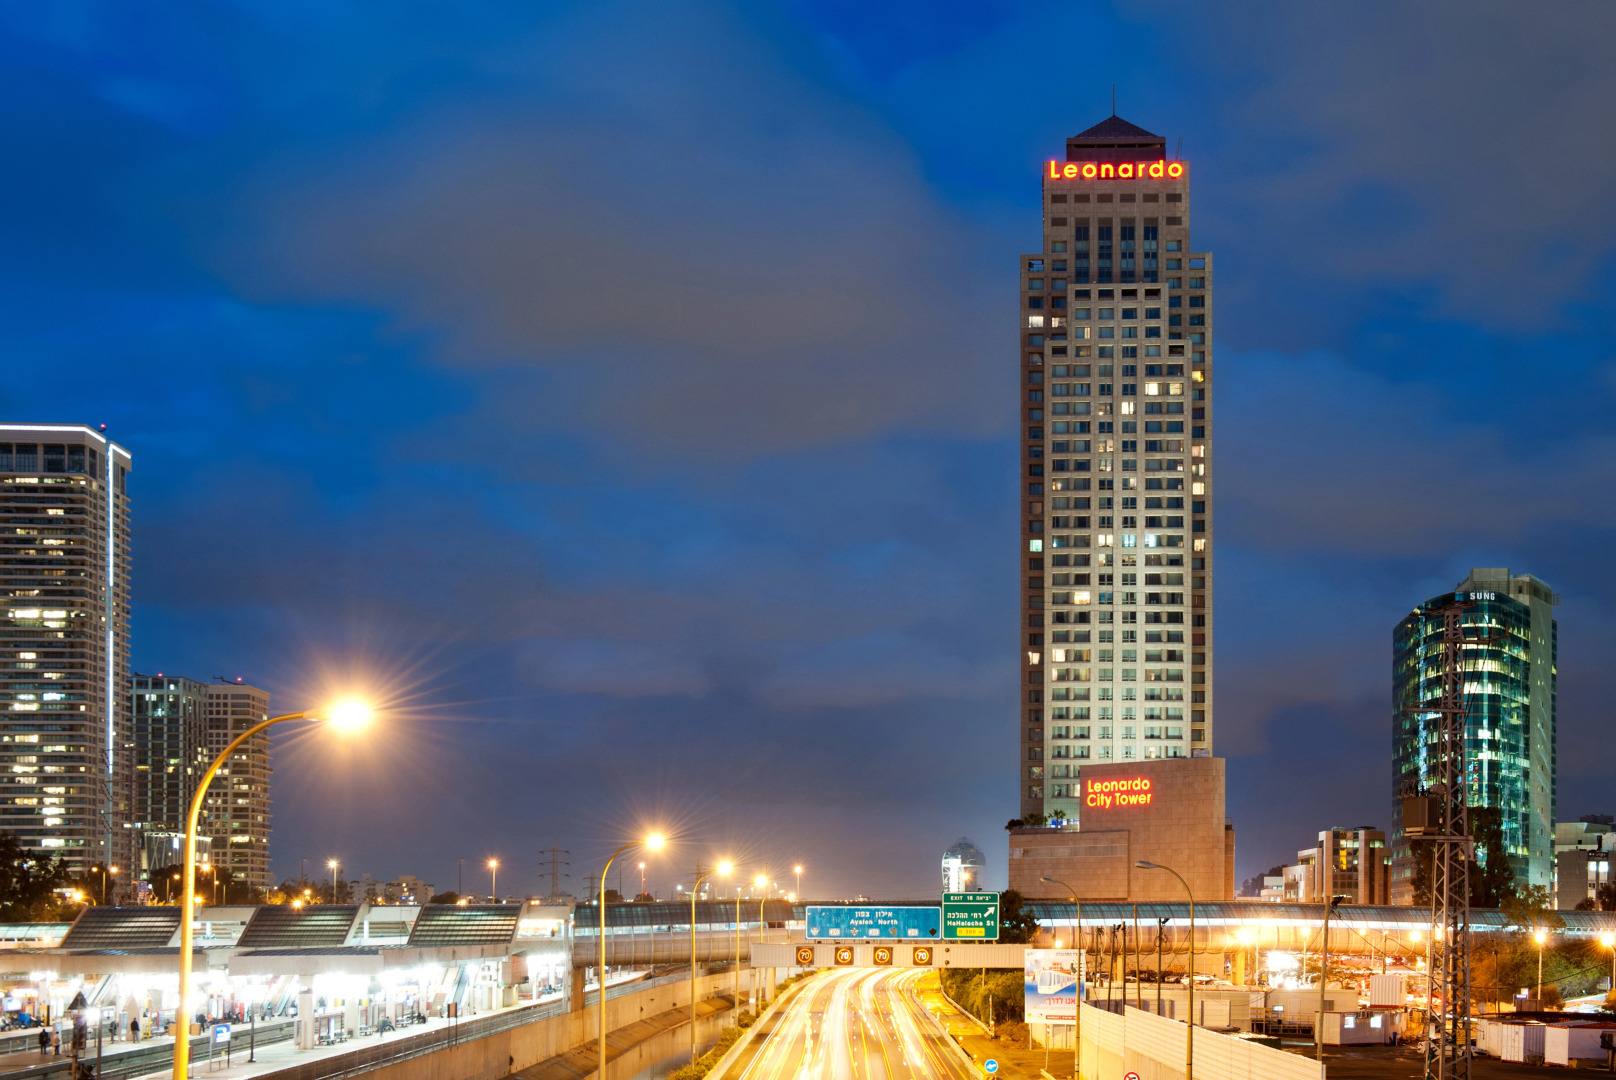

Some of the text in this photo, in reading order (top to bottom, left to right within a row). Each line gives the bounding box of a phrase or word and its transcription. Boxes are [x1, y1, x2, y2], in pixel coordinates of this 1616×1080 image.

[1050, 159, 1183, 178] Leonardo
[1470, 592, 1495, 600] SUNG
[1088, 777, 1150, 792] Leonardo
[1087, 793, 1151, 808] City Tower
[840, 952, 849, 960] 70
[878, 952, 887, 960] 70
[918, 952, 927, 960] 70
